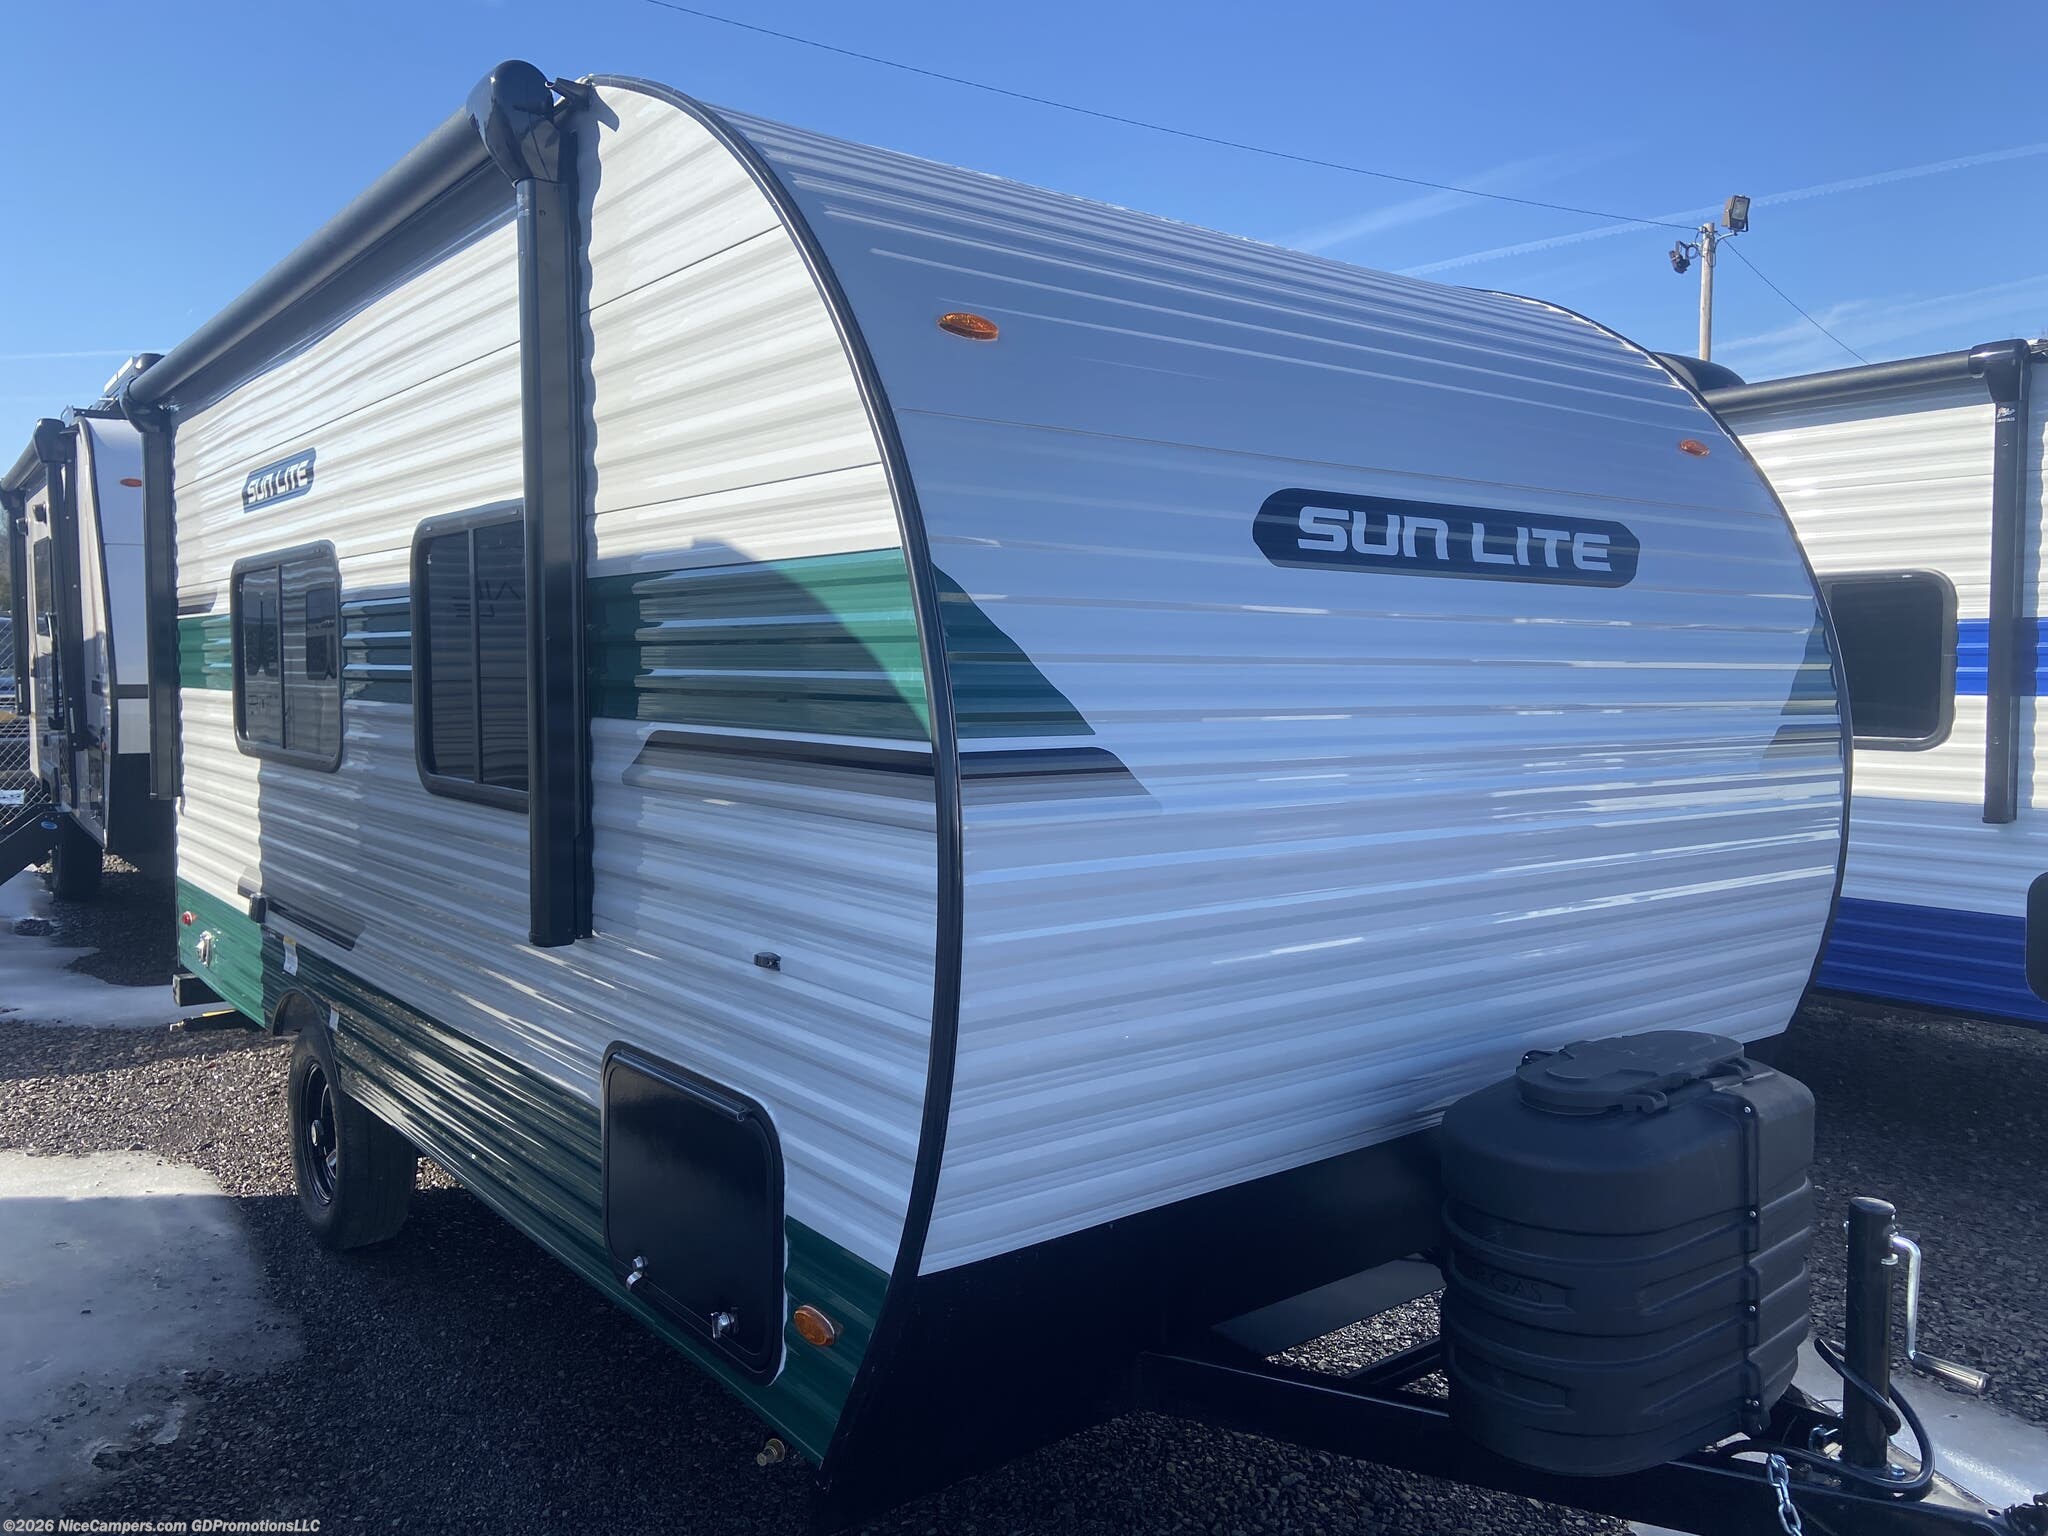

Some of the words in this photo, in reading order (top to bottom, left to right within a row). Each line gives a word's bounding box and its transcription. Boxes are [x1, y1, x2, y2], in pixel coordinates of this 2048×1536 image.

[247, 473, 274, 503] SUN
[276, 460, 310, 494] LITE
[1298, 505, 1449, 560] SUN
[1471, 522, 1612, 572] LITE
